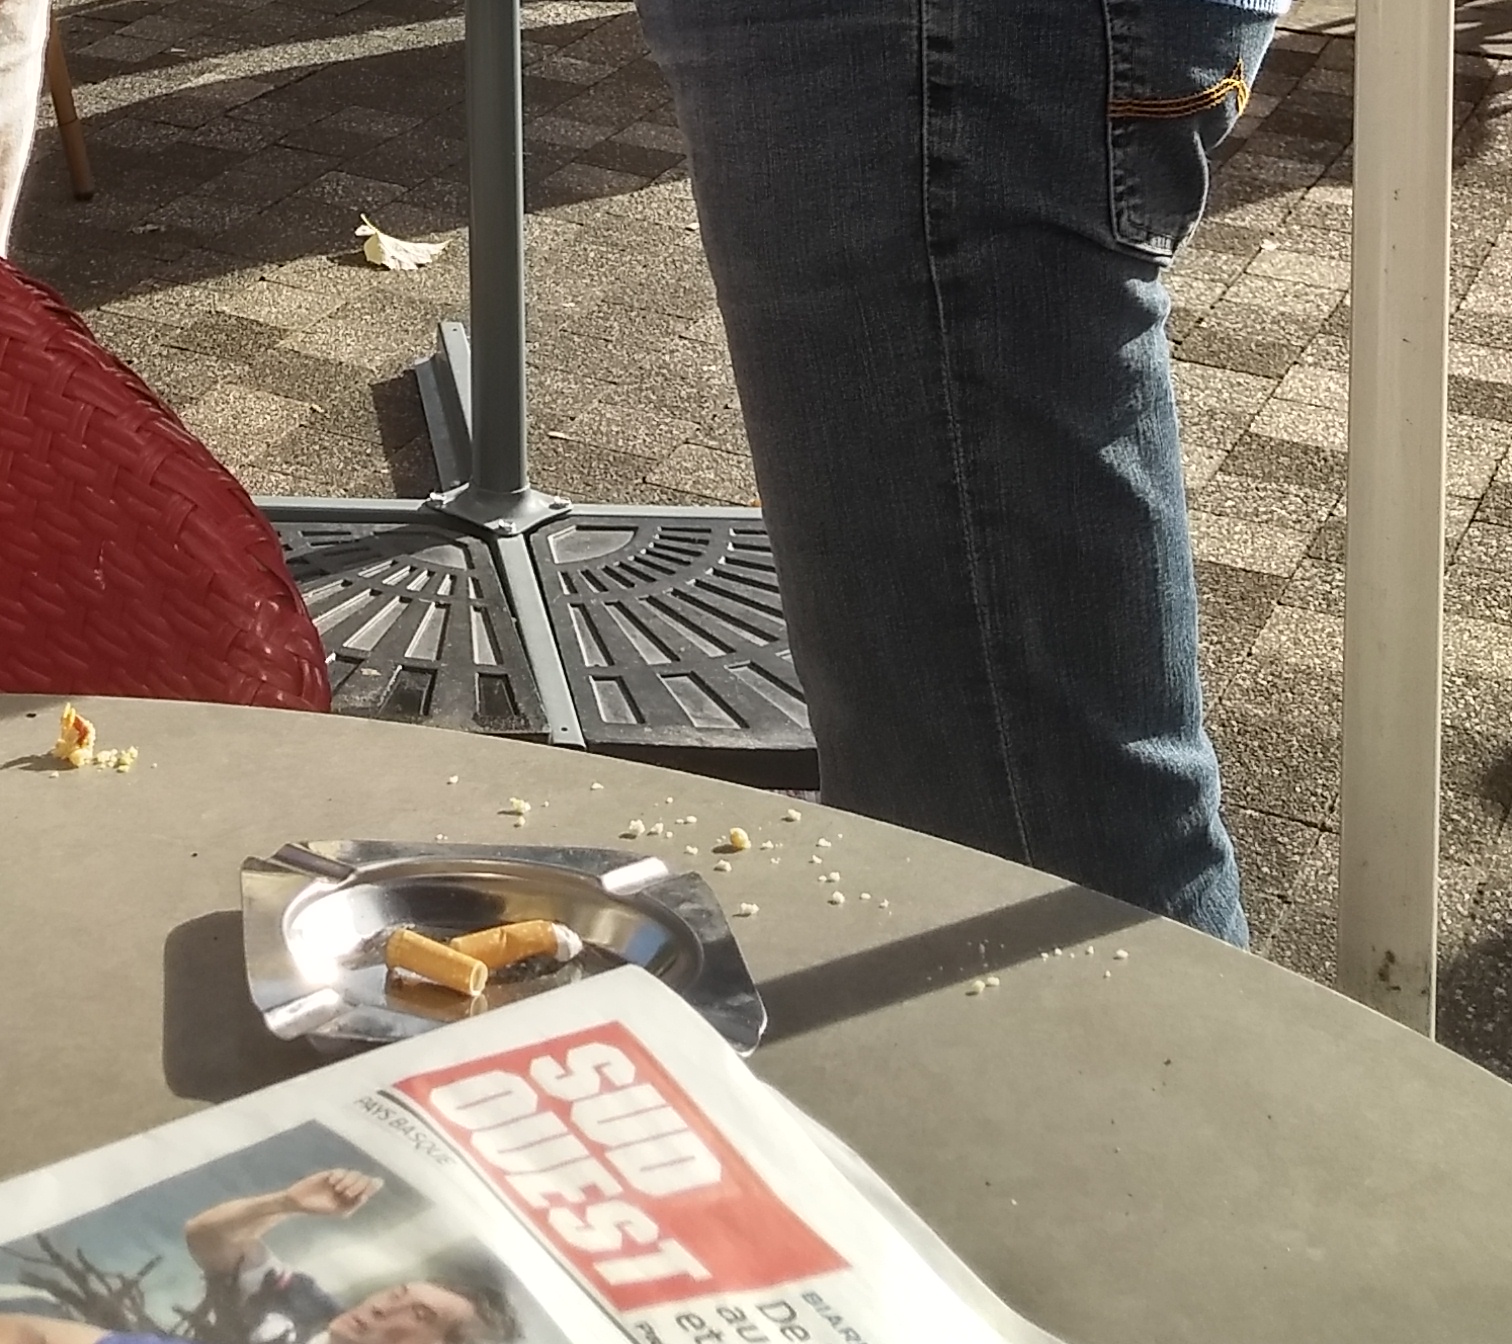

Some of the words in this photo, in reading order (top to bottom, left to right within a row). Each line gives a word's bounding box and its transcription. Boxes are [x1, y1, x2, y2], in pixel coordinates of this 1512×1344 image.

[354, 1095, 393, 1129] PAYS
[389, 1110, 457, 1168] BASQUE
[529, 1040, 722, 1196] SUD
[429, 1067, 713, 1286] OUEST
[801, 1291, 868, 1344] BIAR
